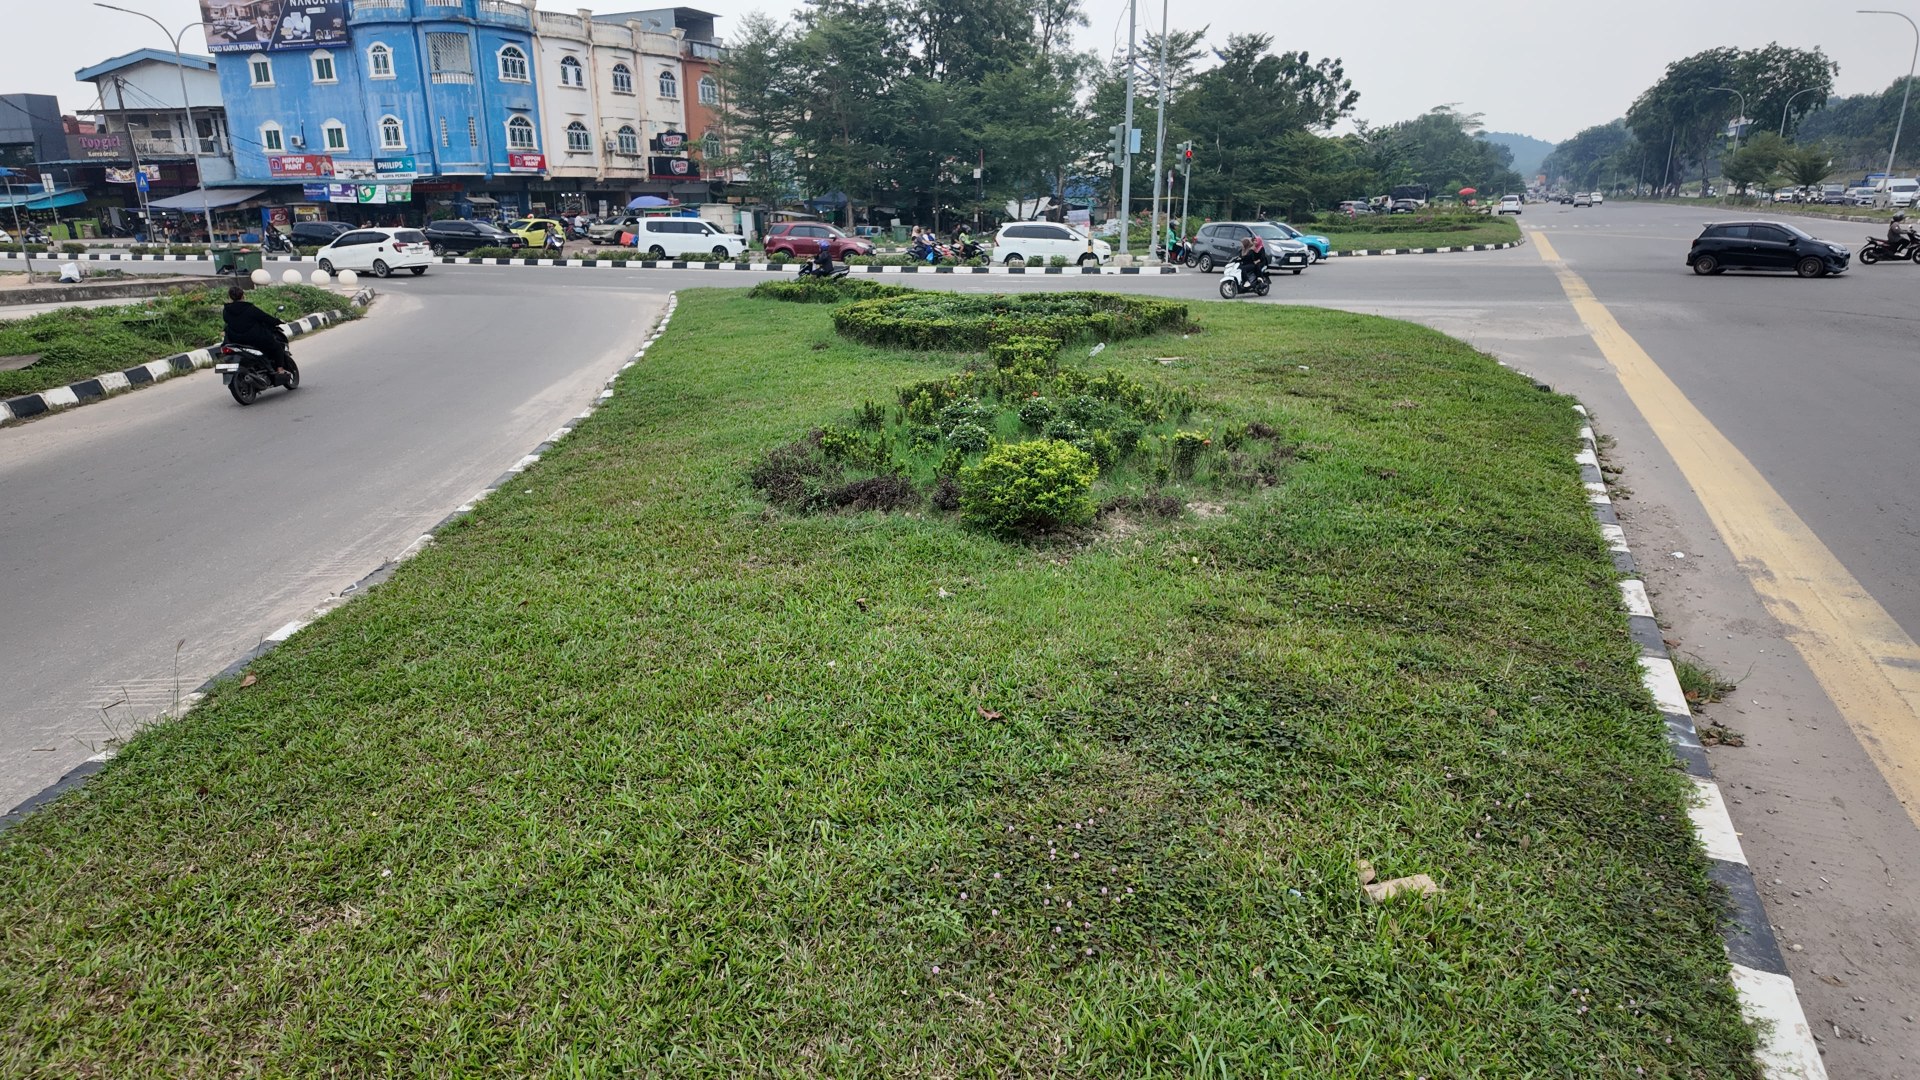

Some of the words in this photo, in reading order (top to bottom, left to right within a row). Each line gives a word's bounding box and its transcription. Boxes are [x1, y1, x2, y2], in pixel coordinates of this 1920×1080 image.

[208, 45, 223, 53] TOKO
[222, 44, 240, 52] KARYA
[238, 43, 263, 51] PERMATA
[282, 156, 305, 164] NIPPON
[285, 163, 302, 171] PAINT
[377, 161, 404, 170] PHILIPS
